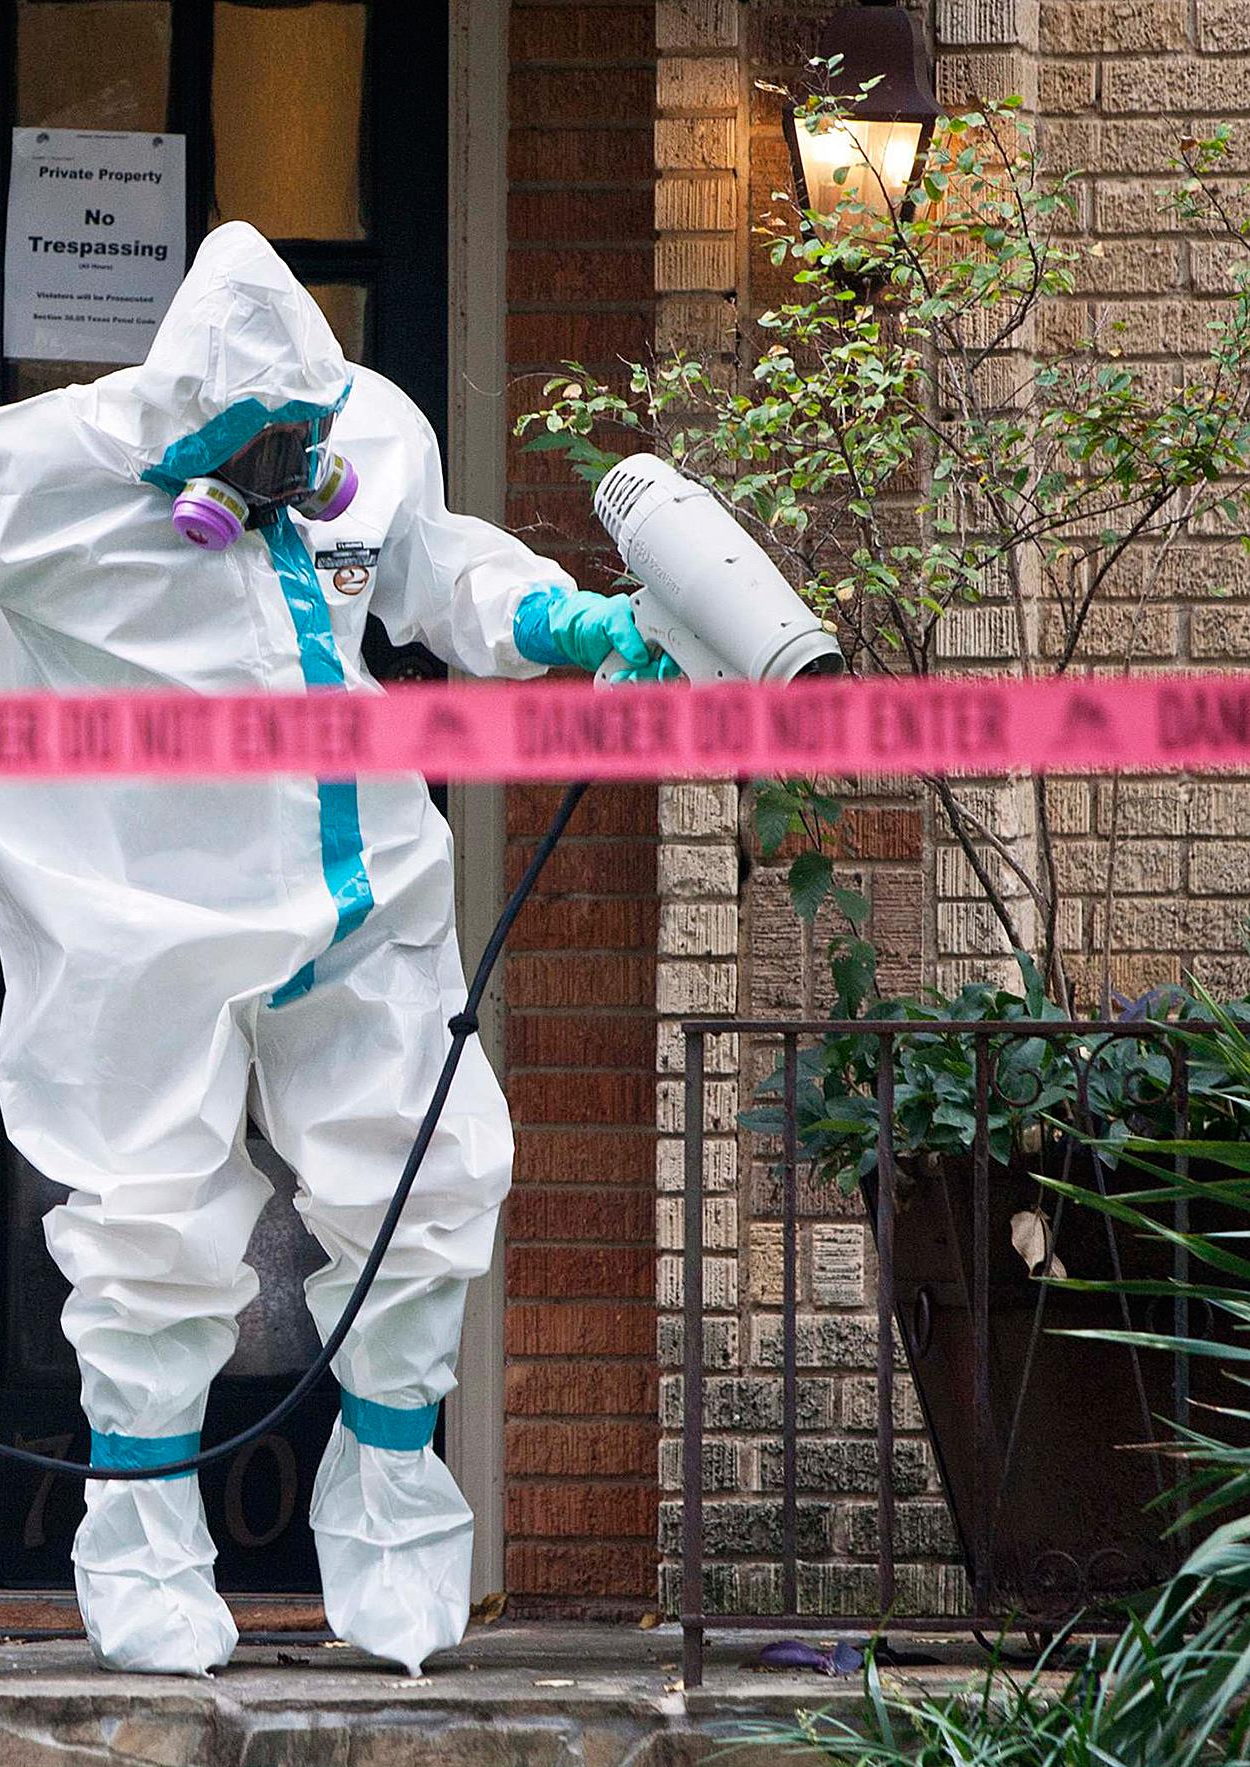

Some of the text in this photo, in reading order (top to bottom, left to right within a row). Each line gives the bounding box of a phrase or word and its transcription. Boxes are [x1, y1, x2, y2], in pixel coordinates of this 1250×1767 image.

[38, 166, 163, 184] Private Property
[84, 209, 115, 226] No
[28, 236, 168, 261] Trespassing
[33, 312, 62, 321] Section
[87, 315, 110, 323] Texas
[112, 316, 135, 324] Penal
